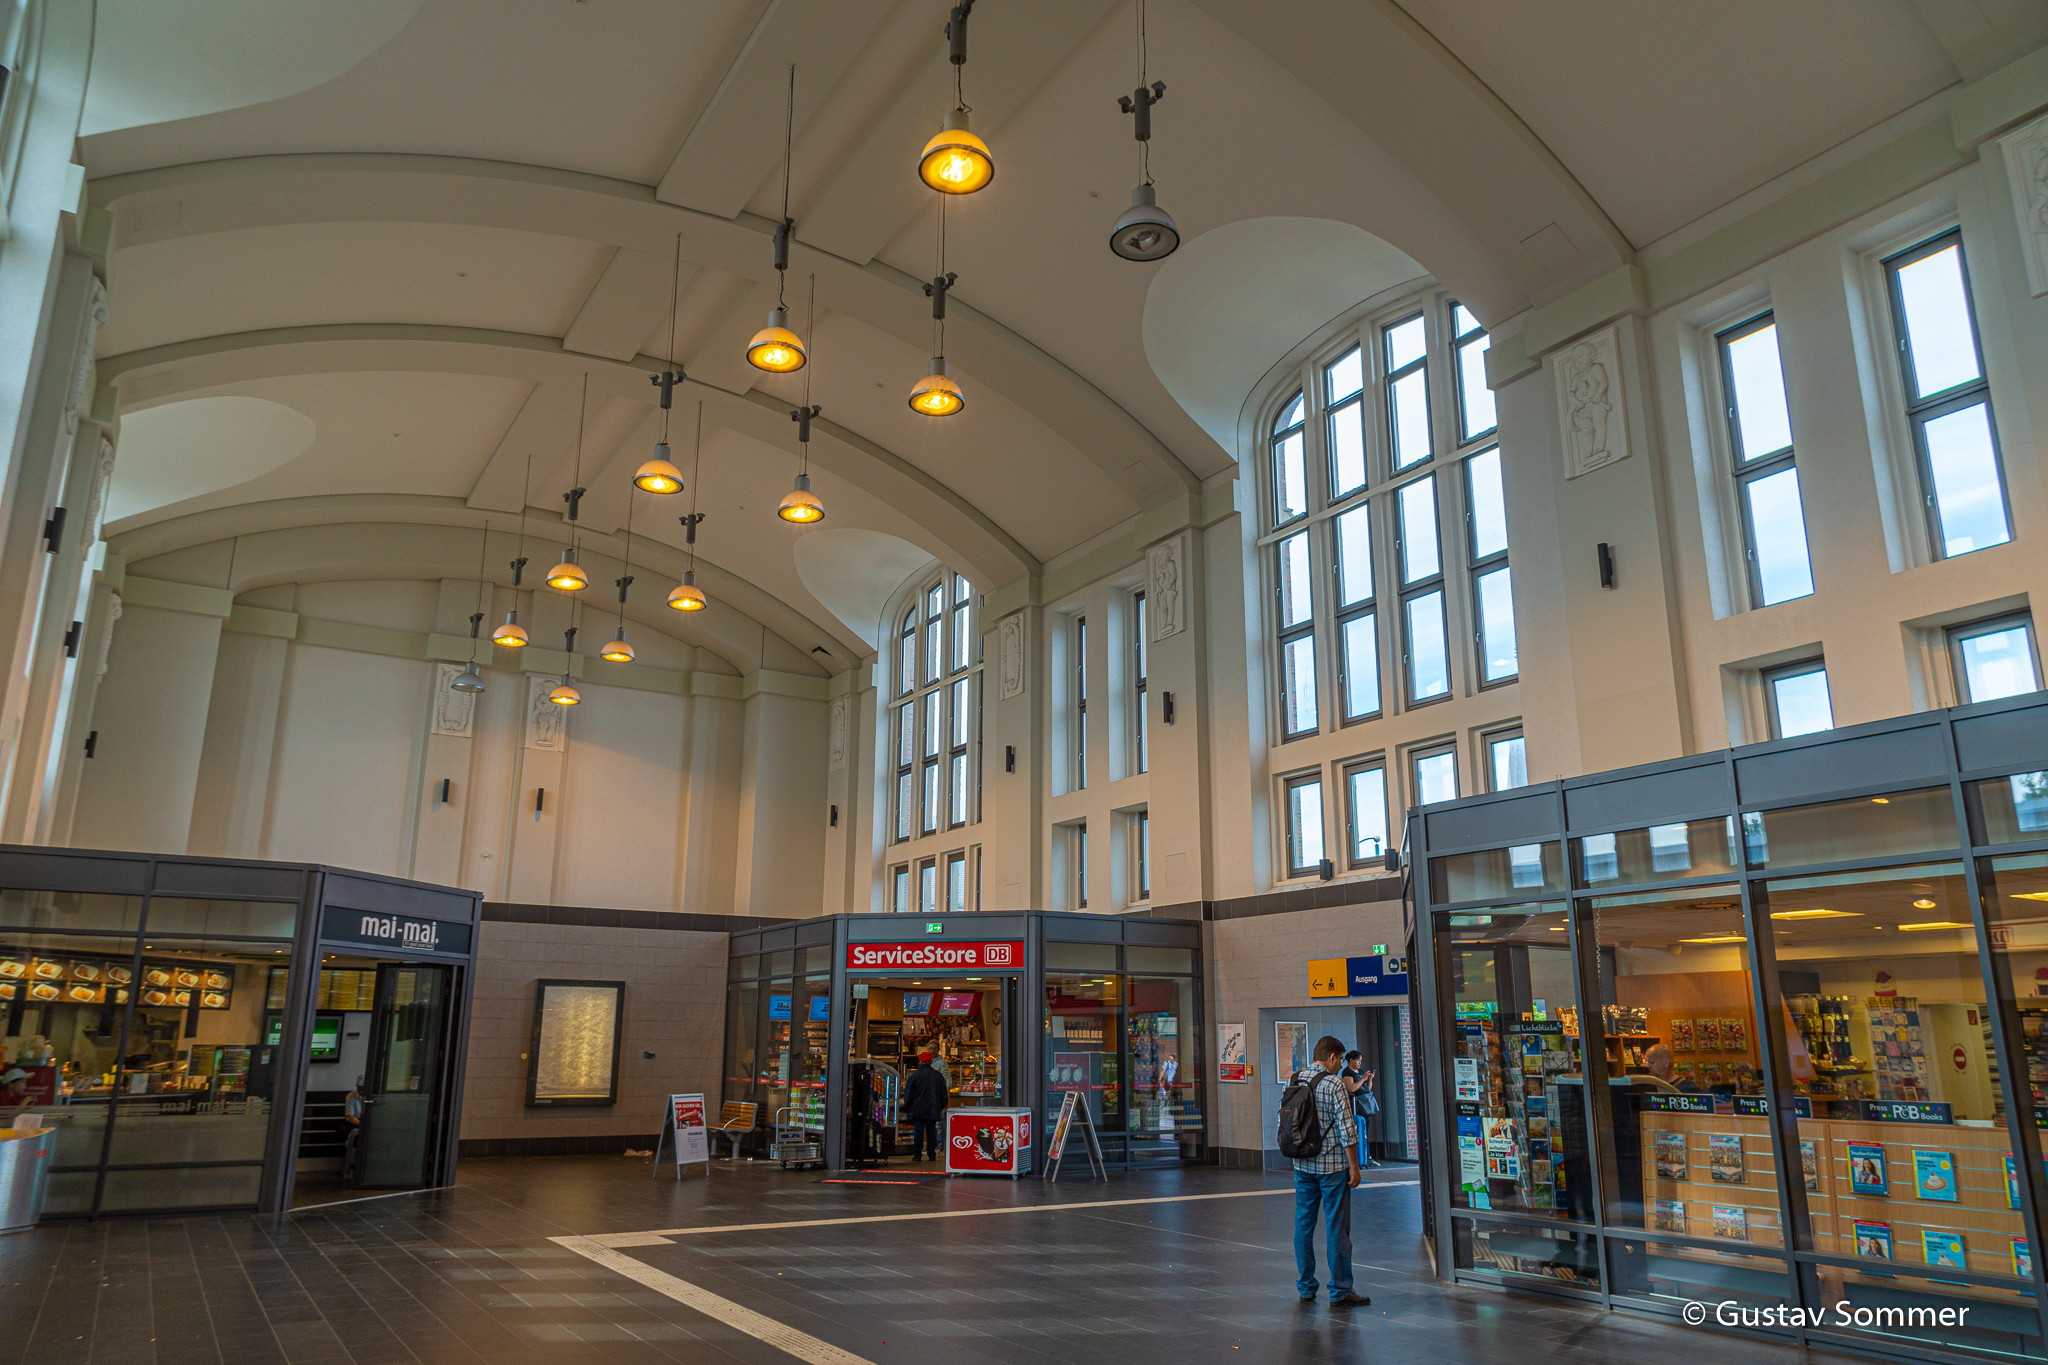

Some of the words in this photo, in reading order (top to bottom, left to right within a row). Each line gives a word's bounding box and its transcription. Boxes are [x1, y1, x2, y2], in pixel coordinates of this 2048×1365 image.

[853, 946, 976, 965] ServiceStore
[1355, 975, 1378, 984] Ausgang
[1869, 1103, 1888, 1111] Press
[1921, 1112, 1943, 1120] Books
